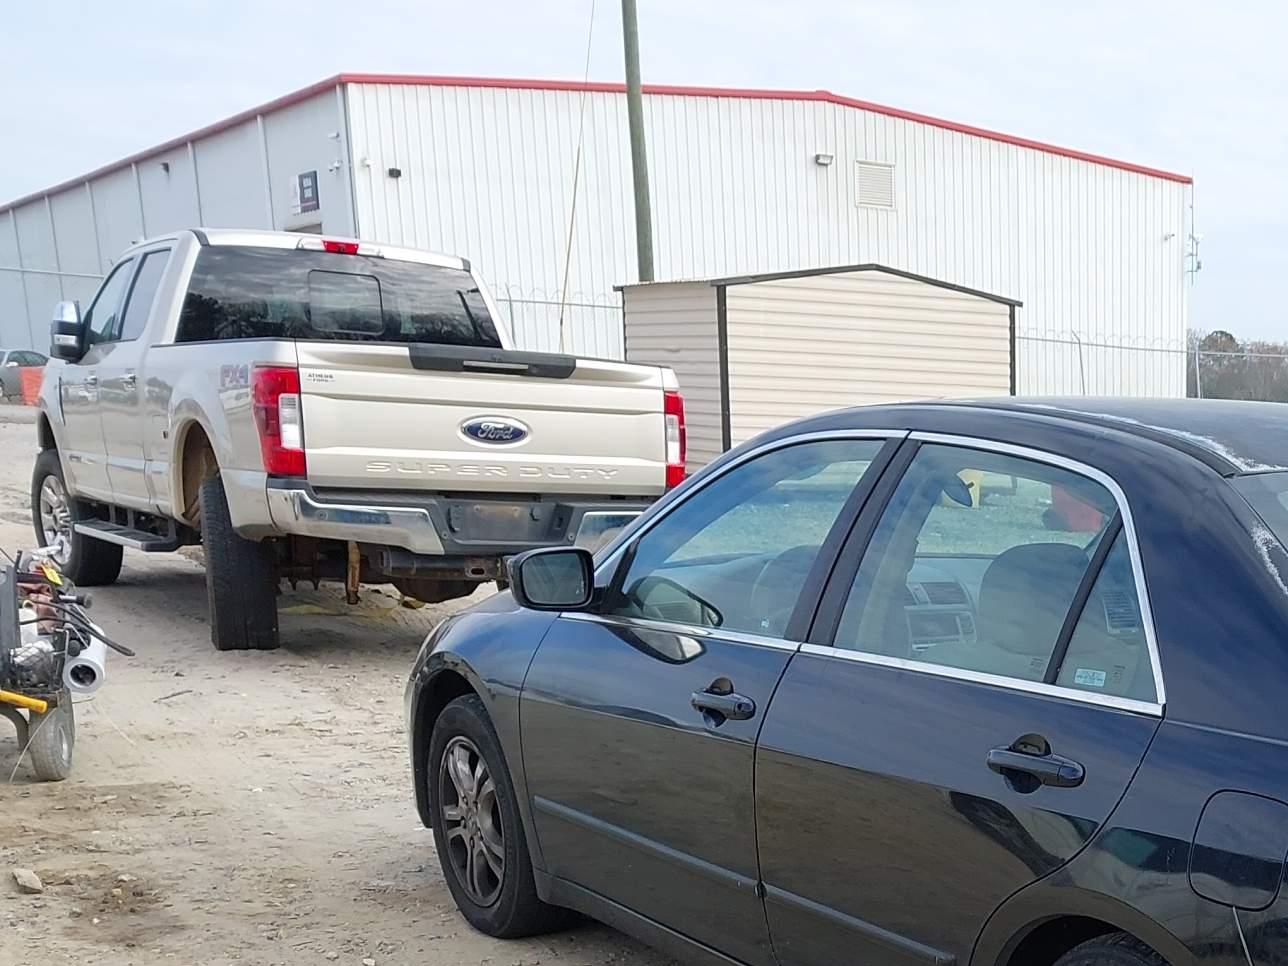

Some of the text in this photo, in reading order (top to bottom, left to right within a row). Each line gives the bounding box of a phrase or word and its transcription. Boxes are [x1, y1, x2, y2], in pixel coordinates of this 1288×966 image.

[477, 422, 514, 440] Ford
[366, 460, 620, 480] SUPER DUTY
